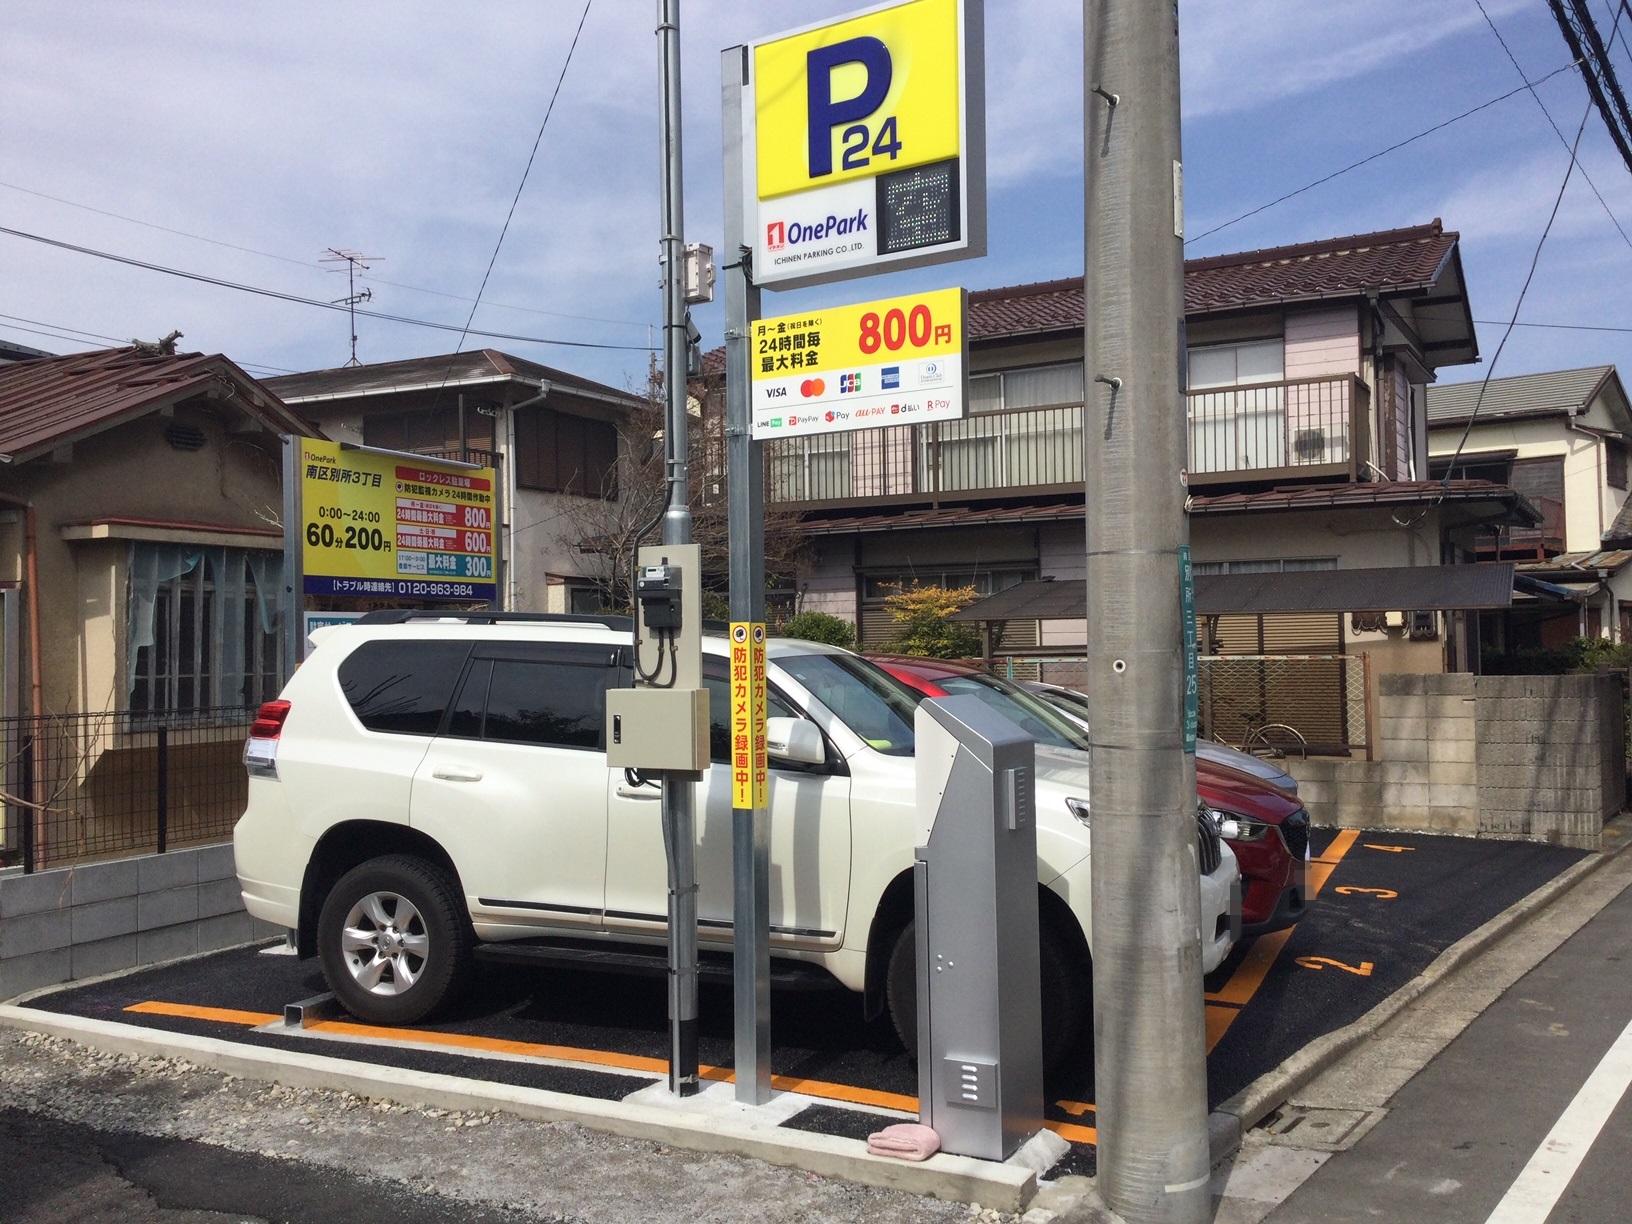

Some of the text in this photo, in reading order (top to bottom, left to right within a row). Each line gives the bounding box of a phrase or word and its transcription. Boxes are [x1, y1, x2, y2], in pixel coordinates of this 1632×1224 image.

[807, 36, 902, 179] P 24
[787, 208, 868, 245] OnePark
[774, 254, 802, 265] ICHINEN
[803, 248, 834, 260] PARKING
[759, 331, 821, 354] 24時間毎
[761, 350, 819, 373] 最大料金
[840, 372, 862, 394] JCB
[766, 387, 787, 399] VISA
[797, 415, 819, 424] PayPay
[836, 411, 850, 420] Pay
[871, 407, 886, 416] PAY
[757, 420, 770, 428] LINE
[310, 453, 337, 464] OnePark
[305, 464, 382, 488] 南区別所3丁目
[398, 581, 473, 596] 0120-963-984
[1186, 674, 1197, 695] 25
[1335, 885, 1398, 899] 3
[1294, 955, 1374, 976] 2
